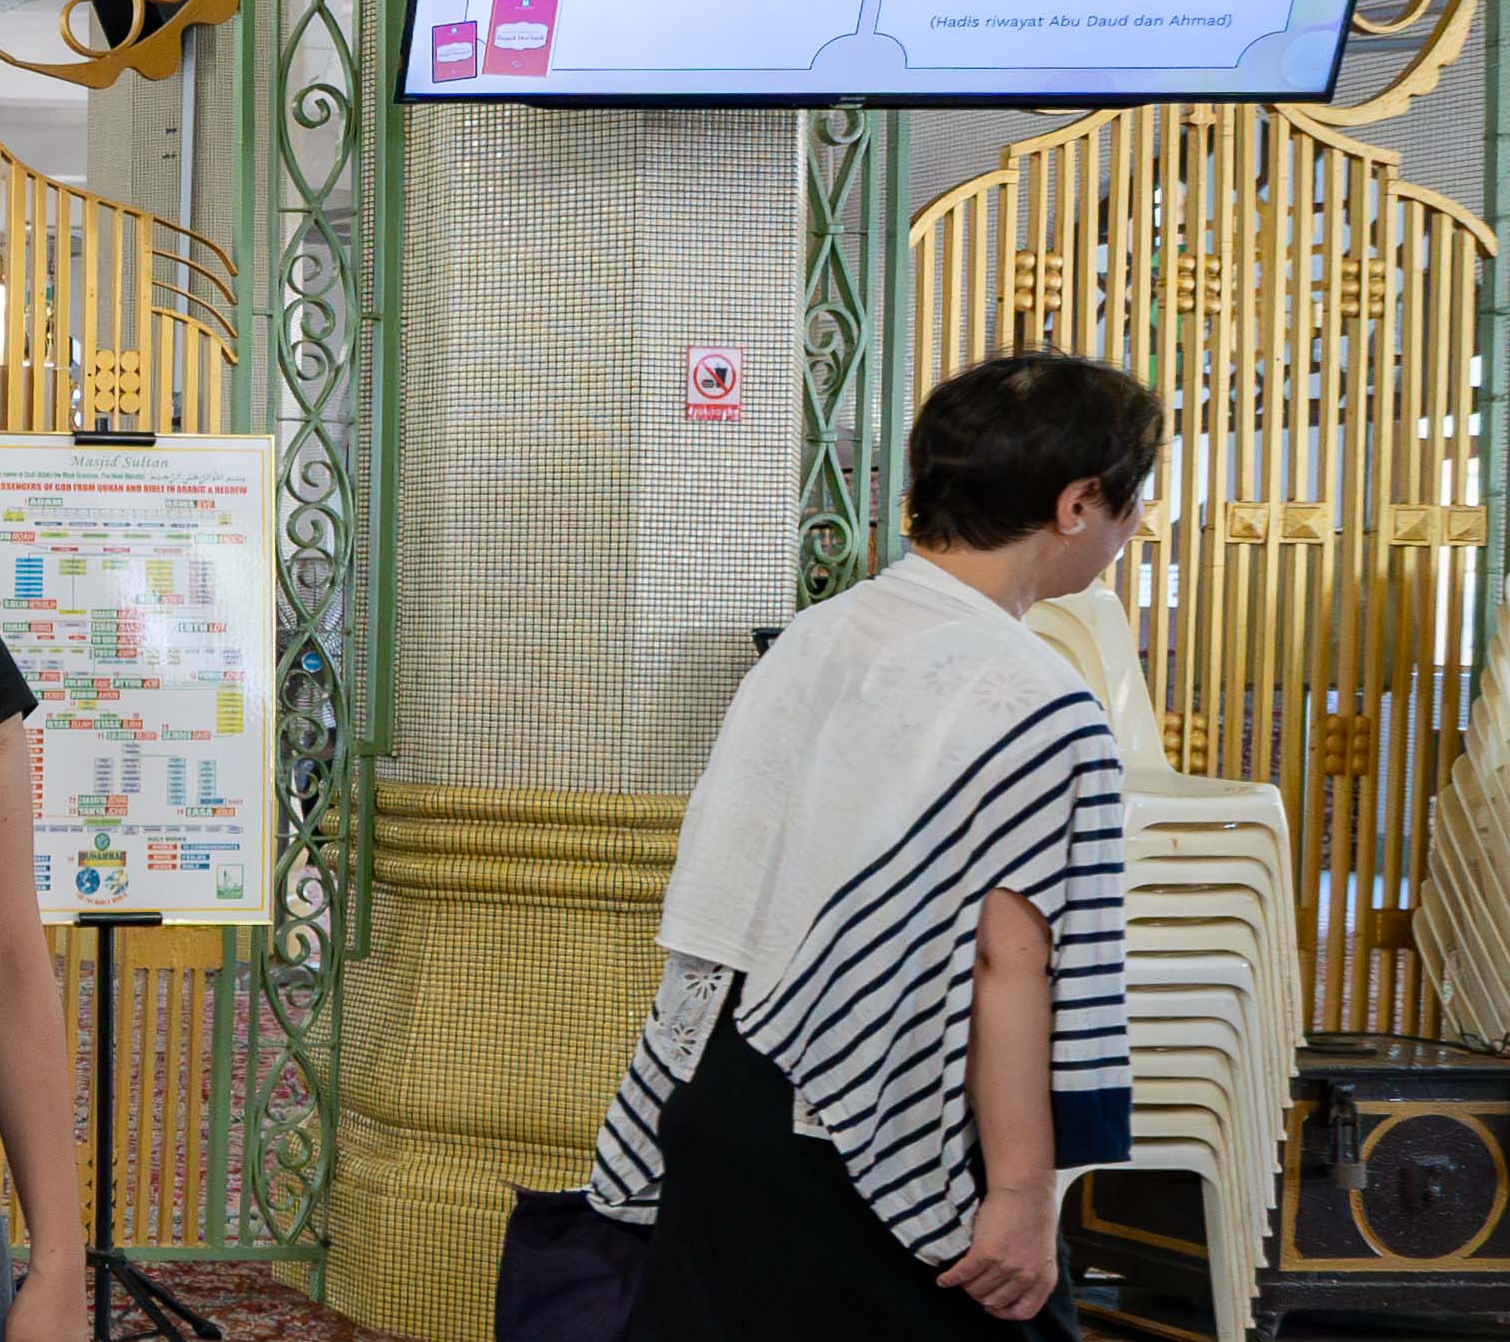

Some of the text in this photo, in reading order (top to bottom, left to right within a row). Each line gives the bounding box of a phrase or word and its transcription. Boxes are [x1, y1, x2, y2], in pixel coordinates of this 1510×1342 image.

[984, 15, 1045, 31] riwayat
[1048, 14, 1081, 27] Abu
[1086, 14, 1129, 28] Daud
[1133, 14, 1164, 27] dan
[69, 455, 170, 470] Masjid Sultan
